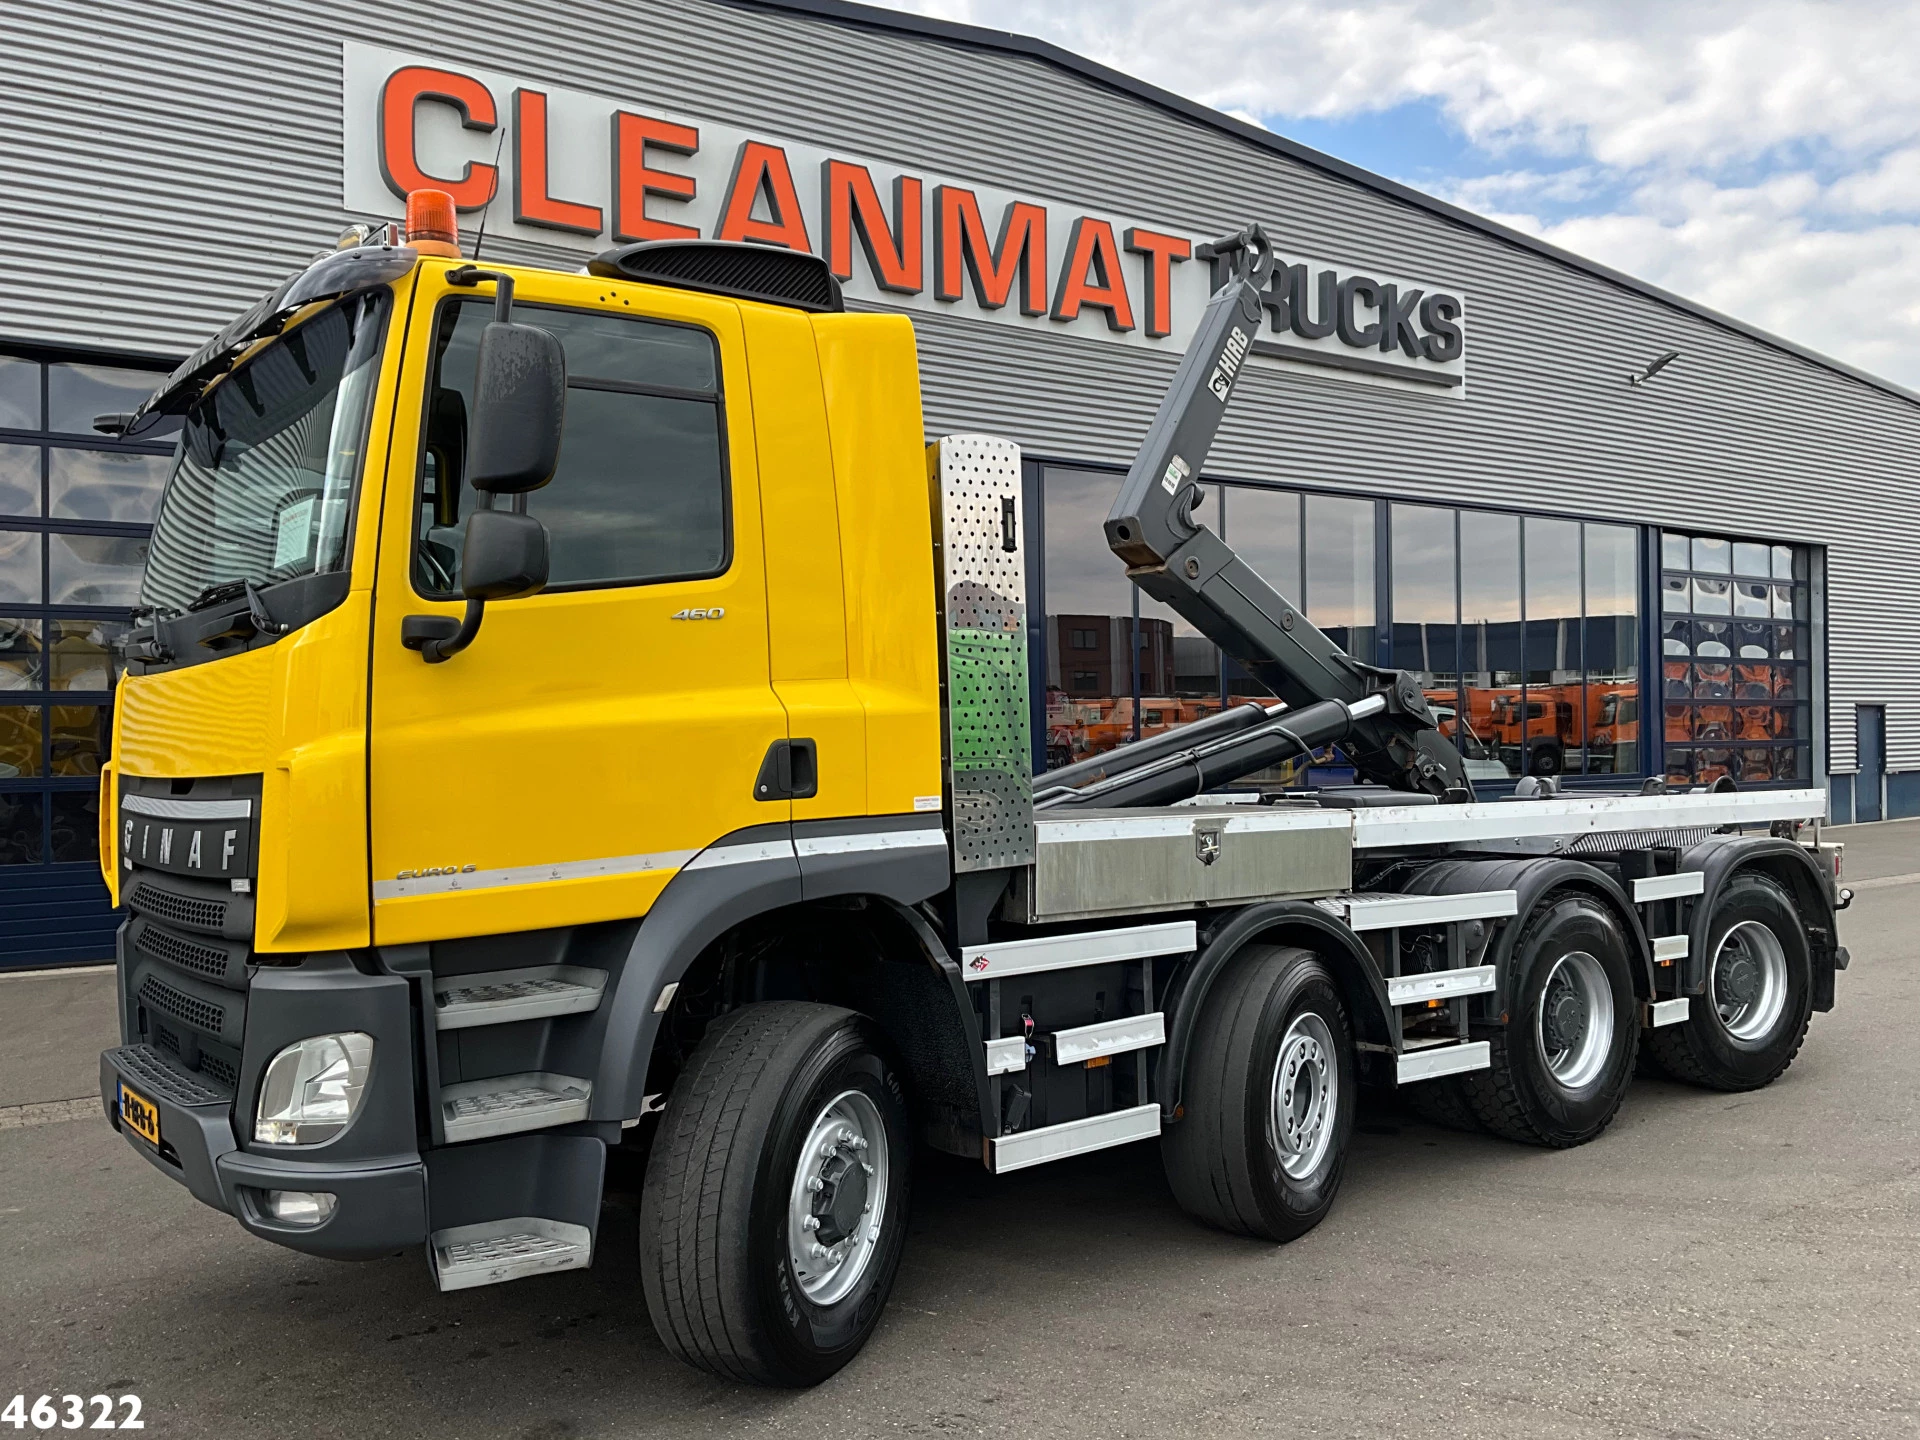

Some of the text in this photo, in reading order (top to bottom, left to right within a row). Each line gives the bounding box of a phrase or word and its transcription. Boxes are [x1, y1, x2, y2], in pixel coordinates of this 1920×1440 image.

[377, 65, 1191, 338] CLEANMAT
[1219, 326, 1249, 378] HIAB
[671, 607, 725, 620] 460
[124, 819, 237, 870] GINAF
[396, 863, 477, 880] EURO 6
